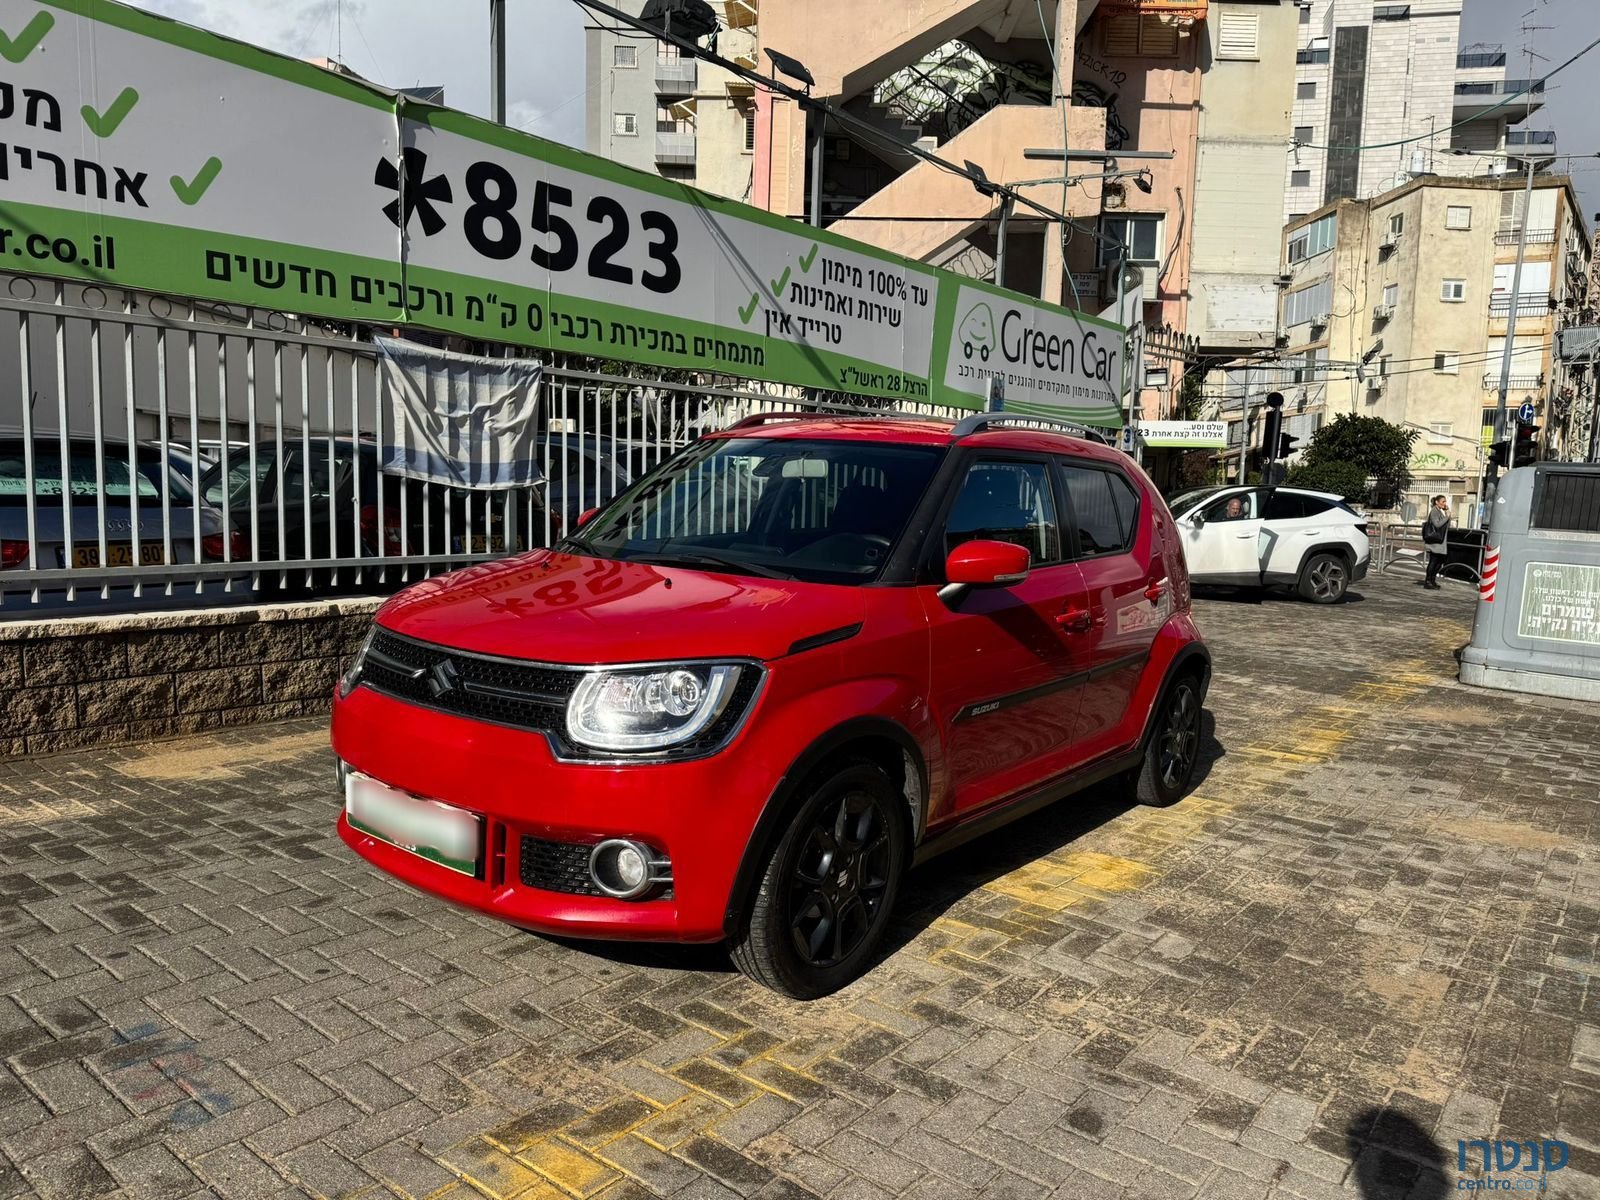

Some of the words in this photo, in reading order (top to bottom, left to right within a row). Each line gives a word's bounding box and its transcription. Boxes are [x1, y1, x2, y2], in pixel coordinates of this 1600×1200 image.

[206, 250, 336, 298] חדשים
[822, 258, 862, 288] מימון
[869, 270, 906, 300] 100%
[351, 275, 453, 316] ורכבים
[790, 282, 853, 317] ואמינות
[911, 285, 928, 306] עד
[527, 303, 542, 331] 0
[551, 312, 602, 341] רכבי
[765, 309, 791, 337] אין
[858, 300, 901, 327] שירות
[610, 322, 687, 354] במכירת
[797, 316, 842, 344] טרייד
[694, 336, 764, 366] מתמחים
[1001, 309, 1074, 374] Green
[1081, 331, 1116, 382] Car
[887, 375, 900, 391] 28
[958, 364, 975, 379] רכב
[903, 376, 928, 396] הרצל
[1542, 603, 1595, 619] שומרים
[971, 702, 1000, 716] SUZUKI
